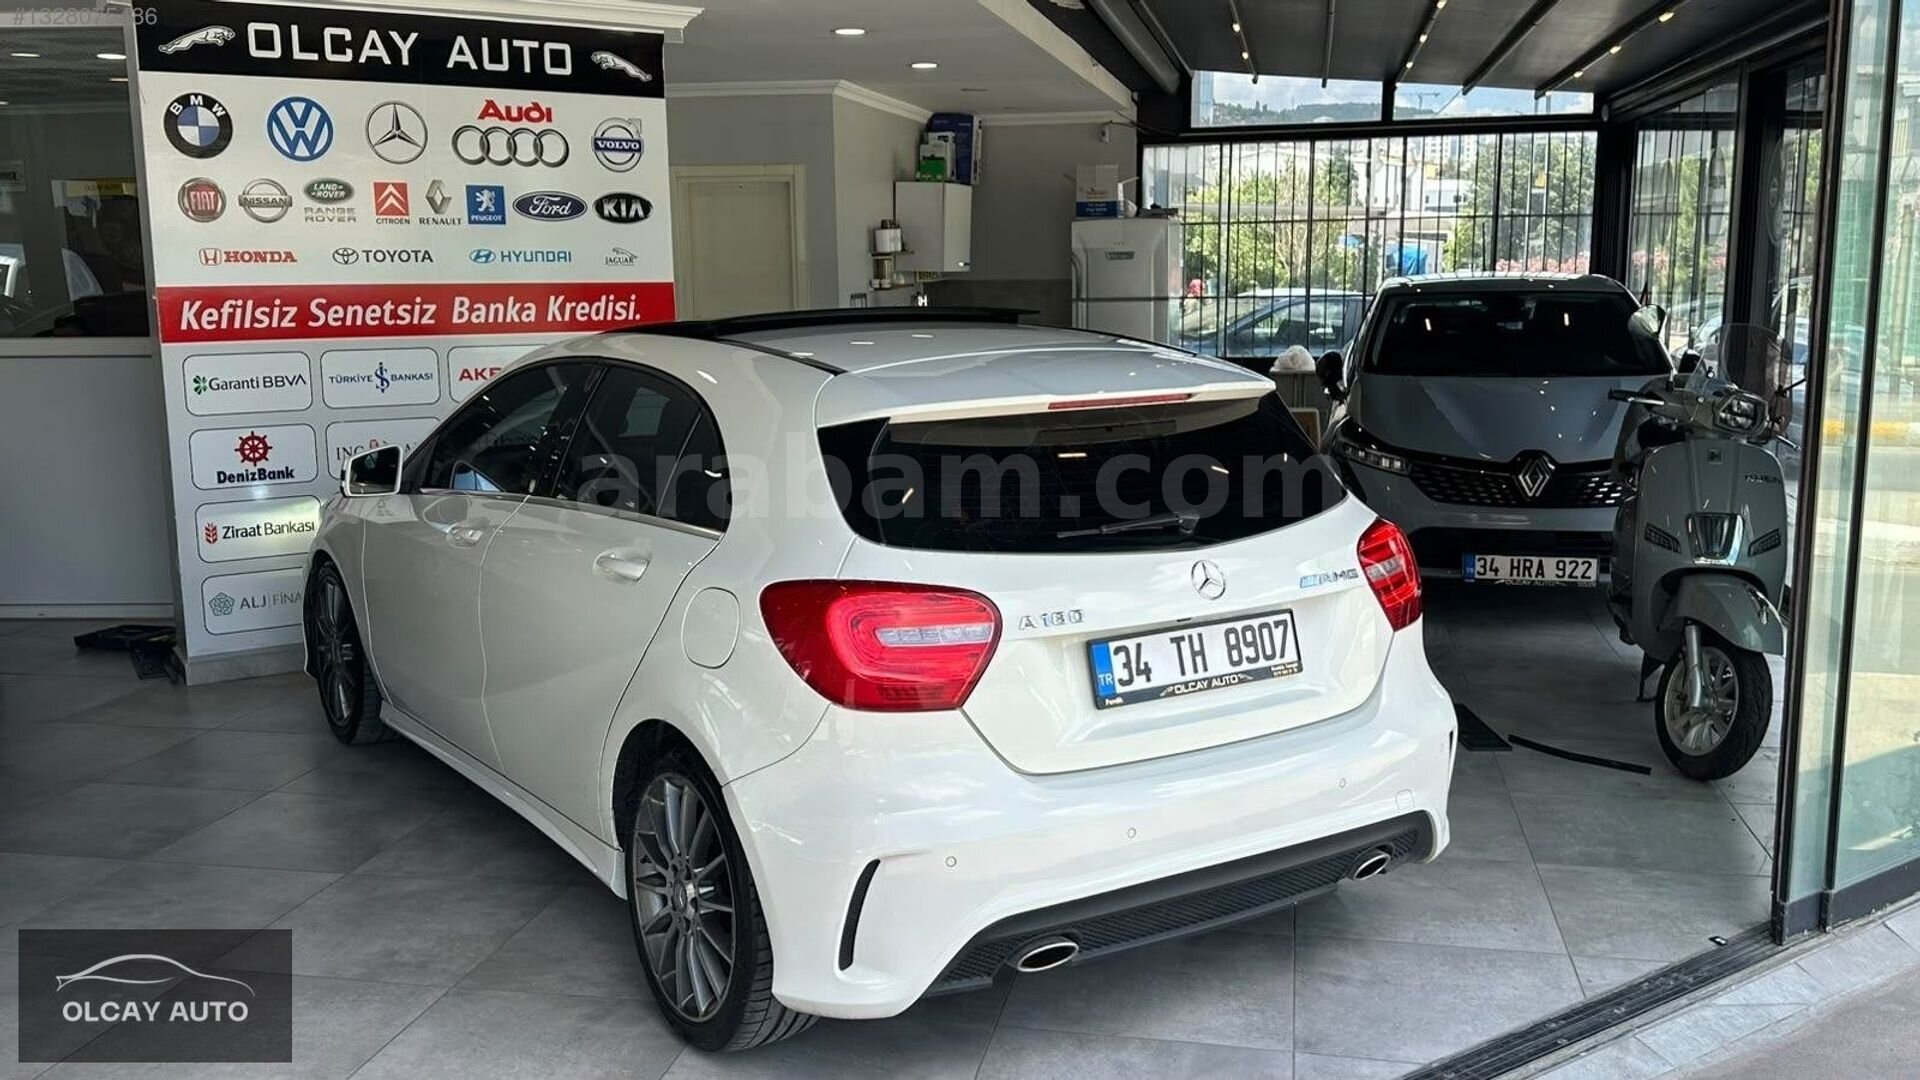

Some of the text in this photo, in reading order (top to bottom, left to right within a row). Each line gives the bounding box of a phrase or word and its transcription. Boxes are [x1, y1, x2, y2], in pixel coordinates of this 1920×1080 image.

[247, 22, 572, 76] OLCAY AUTO
[169, 95, 226, 118] BMW
[477, 99, 553, 124] Audi
[594, 139, 641, 151] VOLVO
[313, 183, 338, 191] LAND
[315, 190, 346, 199] ROVER
[189, 191, 217, 211] FIAT
[242, 196, 288, 205] NISSAN
[529, 194, 572, 216] Ford
[304, 207, 356, 215] RANGE
[602, 199, 646, 219] KIA
[418, 217, 462, 226] RENAULT
[471, 214, 503, 222] PEUGEOT
[223, 250, 298, 263] HONDA
[363, 249, 434, 263] TOYOTA
[500, 250, 572, 263] HYUNDAI
[605, 255, 634, 266] JAGUAR
[180, 293, 641, 330] Kefilsiz Senetsiz Banka Kredisi.
[328, 373, 374, 384] TÜRKİYE
[390, 372, 433, 381] BANKASI
[458, 367, 502, 382] AK
[208, 374, 307, 392] Garanti BBVA
[216, 465, 295, 484] DenizBank
[222, 520, 315, 540] Ziraat Bankası
[1476, 557, 1592, 580] 34 HRA 922
[240, 595, 266, 609] ALJ
[1018, 615, 1038, 631] A
[1113, 619, 1289, 687] 34 TH 8907
[1098, 673, 1114, 686] TR
[1174, 673, 1240, 695] OLCAY AUTO
